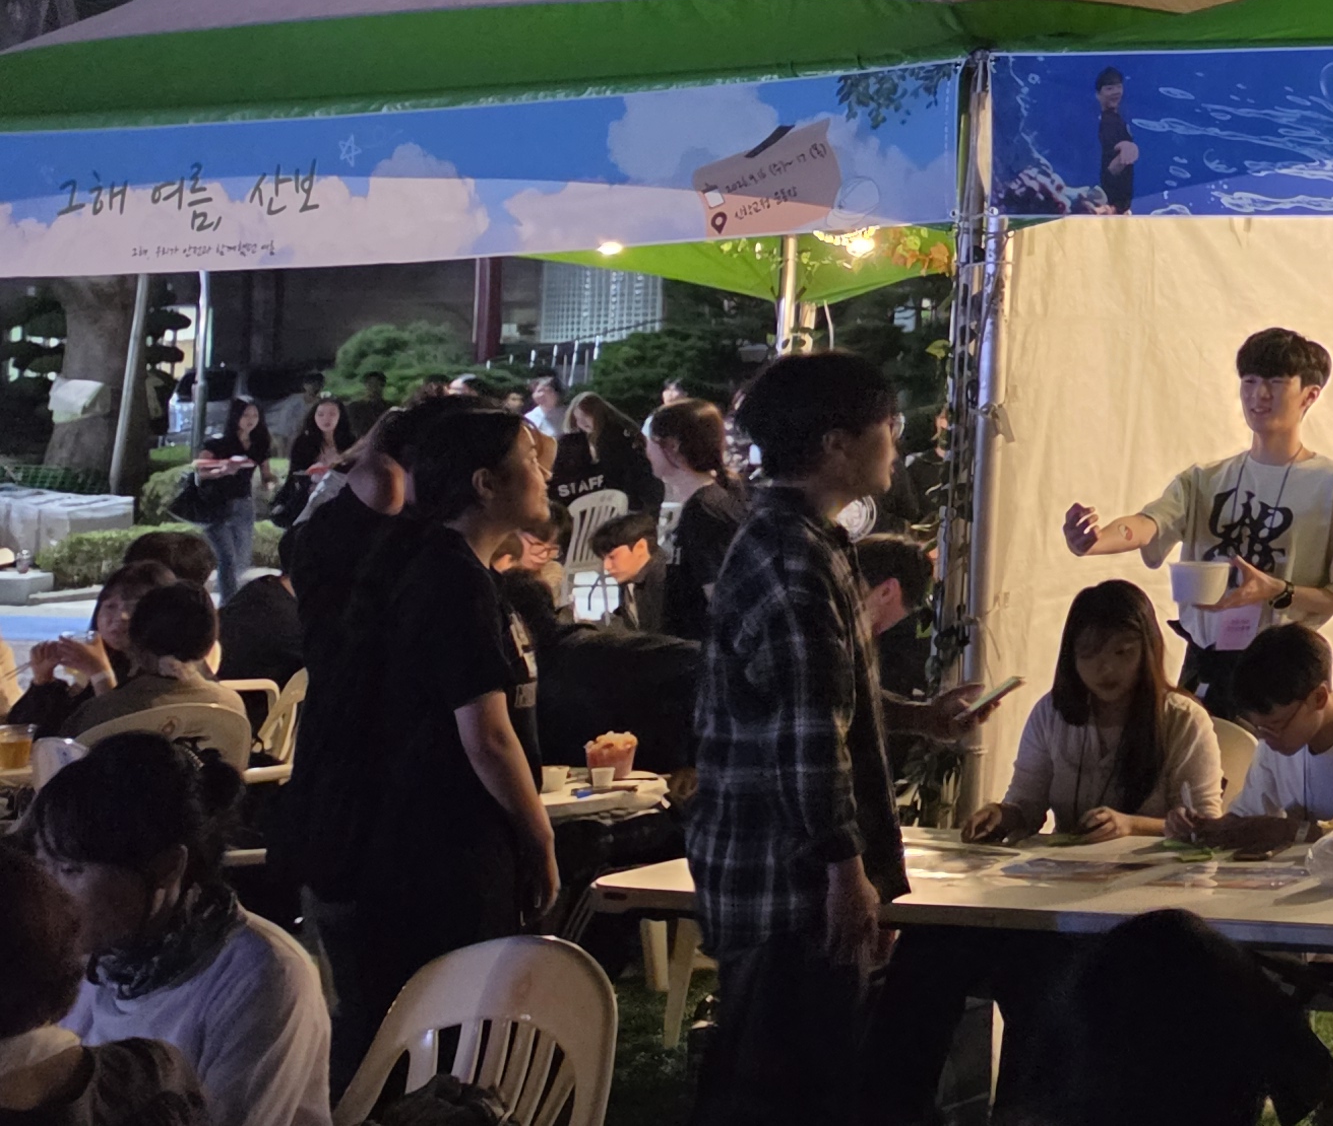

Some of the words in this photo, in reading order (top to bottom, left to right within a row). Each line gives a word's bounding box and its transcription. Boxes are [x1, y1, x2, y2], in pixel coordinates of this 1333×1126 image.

[57, 170, 129, 216] 그해
[150, 162, 222, 232] 여름,
[249, 158, 319, 216] 산보
[557, 474, 605, 498] STAFF
